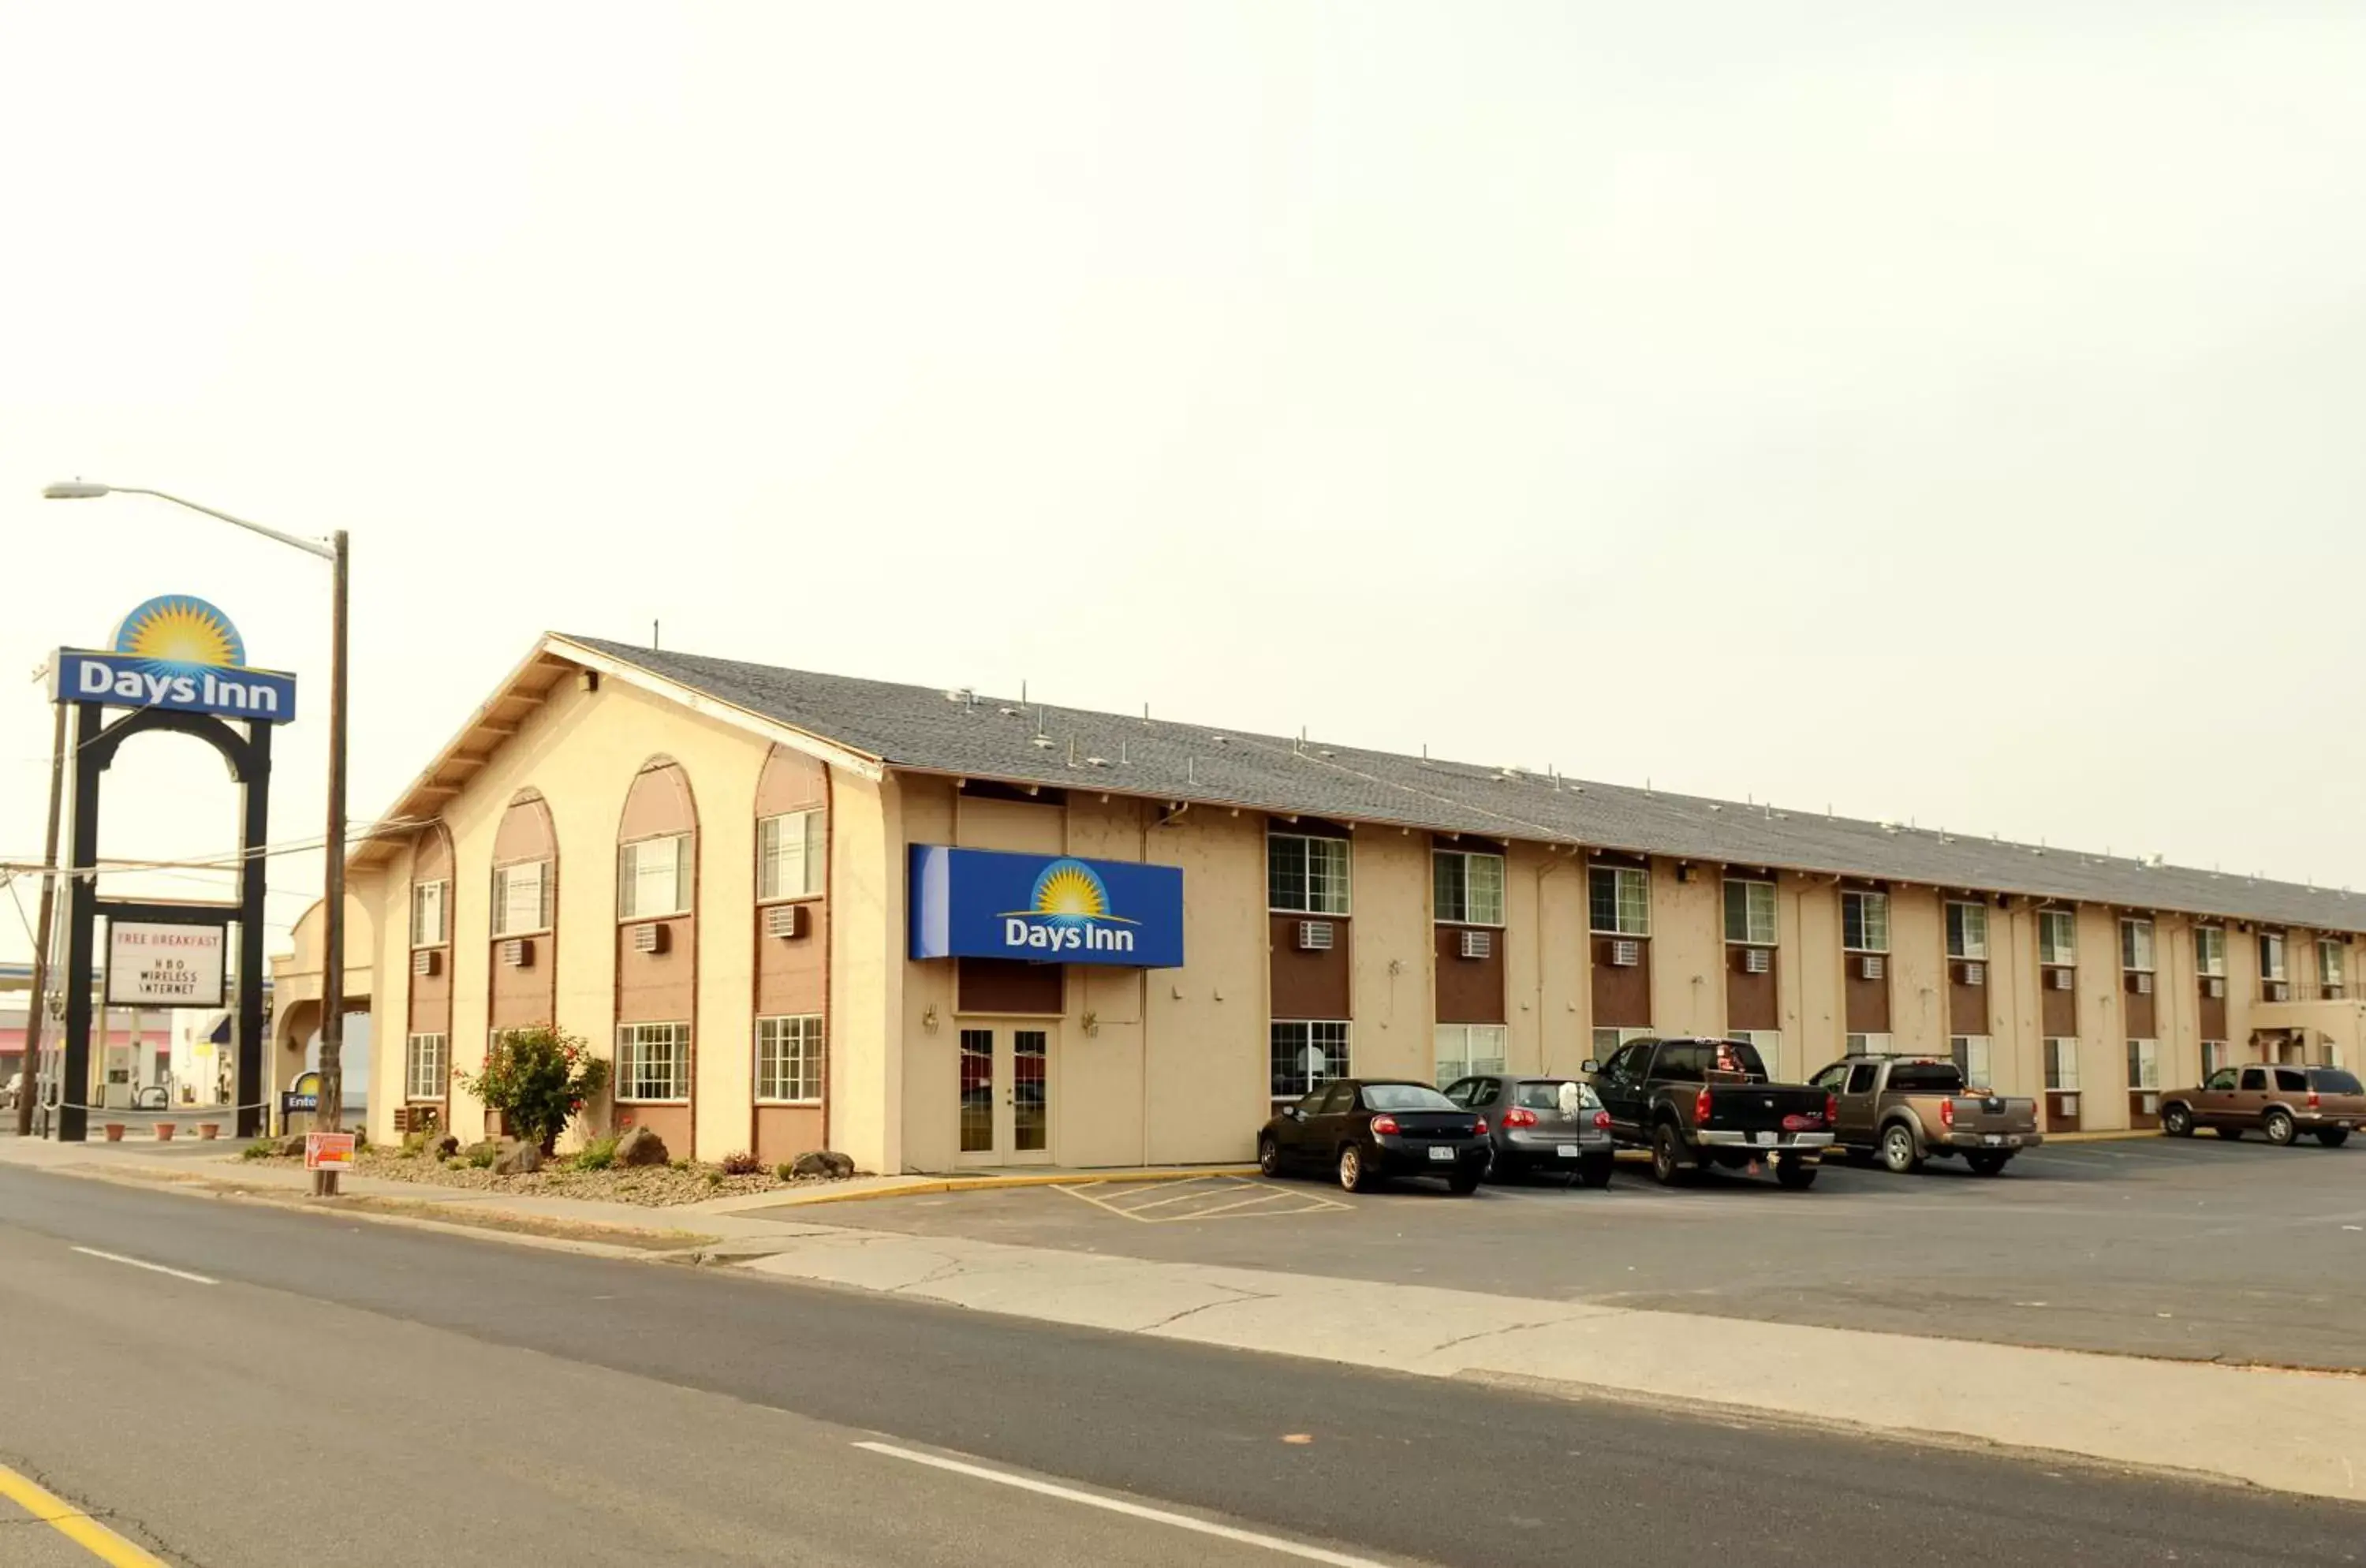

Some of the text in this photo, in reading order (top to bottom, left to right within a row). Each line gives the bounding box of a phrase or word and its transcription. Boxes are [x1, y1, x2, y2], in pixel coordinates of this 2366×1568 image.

[80, 659, 278, 711] Days Inn
[118, 932, 219, 947] FREE BREAKFAST
[1006, 918, 1134, 952] Days Inn
[140, 971, 197, 983] WIRELESS
[139, 983, 196, 995] INTERNET
